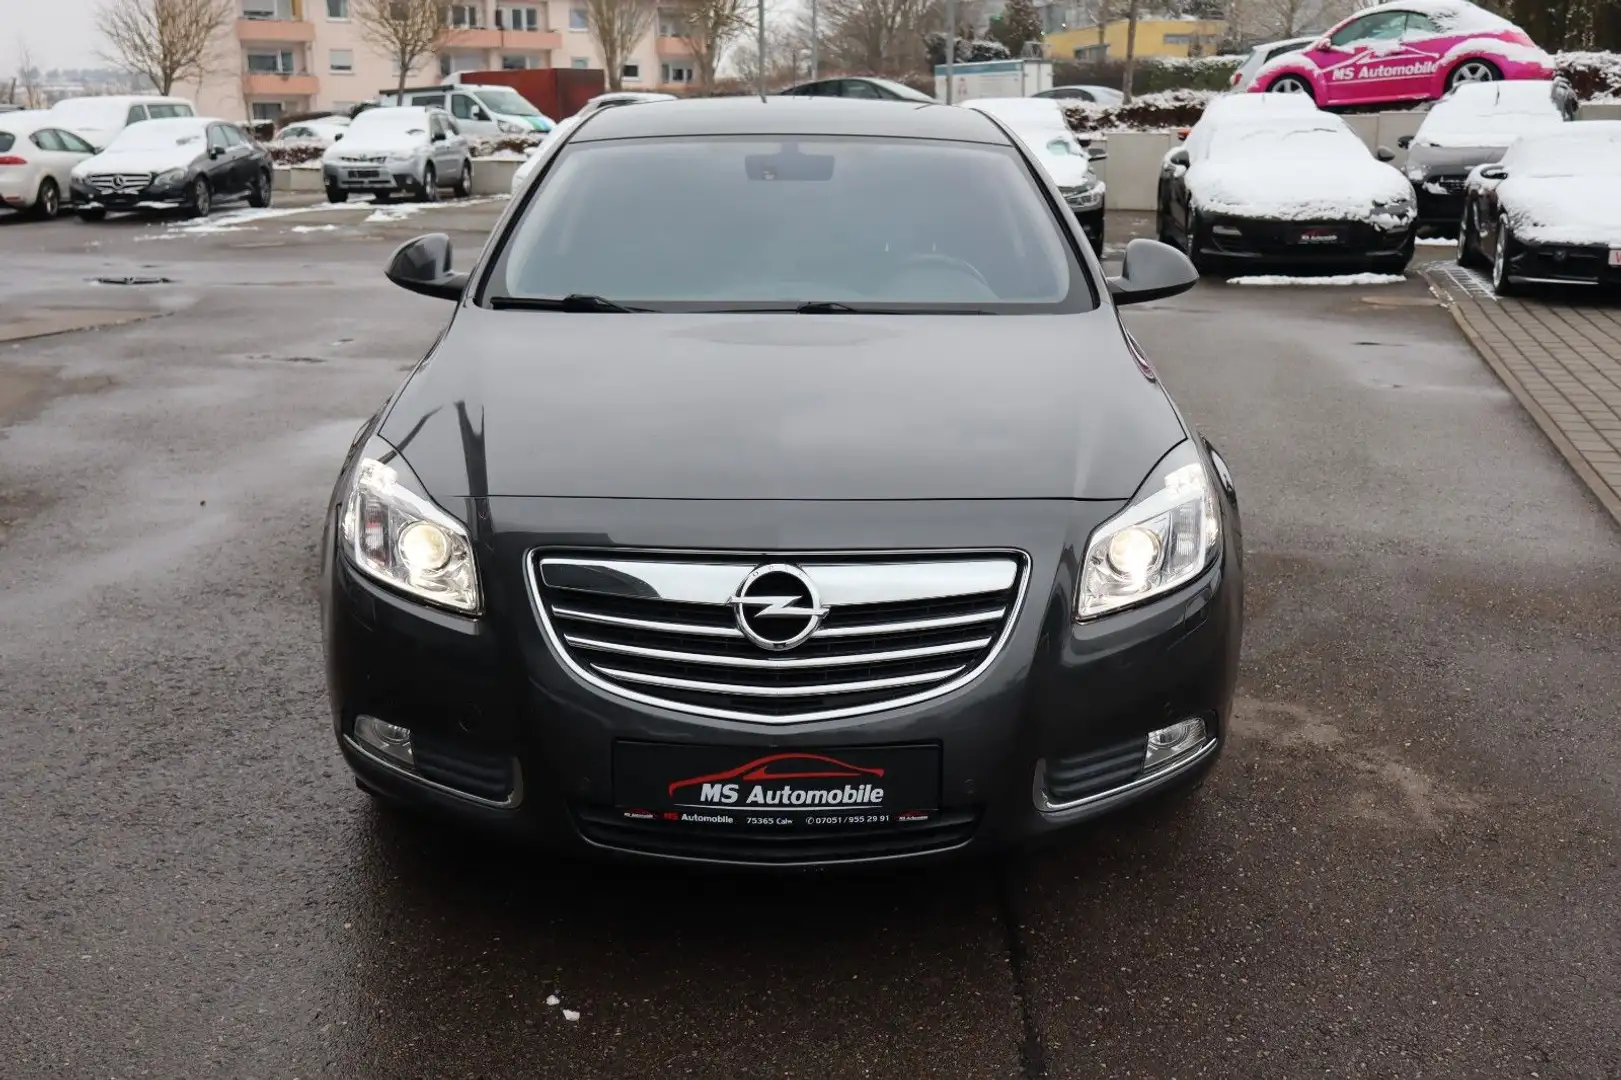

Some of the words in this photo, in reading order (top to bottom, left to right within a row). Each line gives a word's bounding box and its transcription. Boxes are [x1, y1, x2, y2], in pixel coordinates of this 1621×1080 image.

[1333, 67, 1354, 80] MS
[700, 783, 739, 804] MS
[746, 783, 884, 805] Automobile
[681, 813, 734, 824] Automobile
[746, 817, 774, 825] 75365
[867, 815, 878, 823] 29
